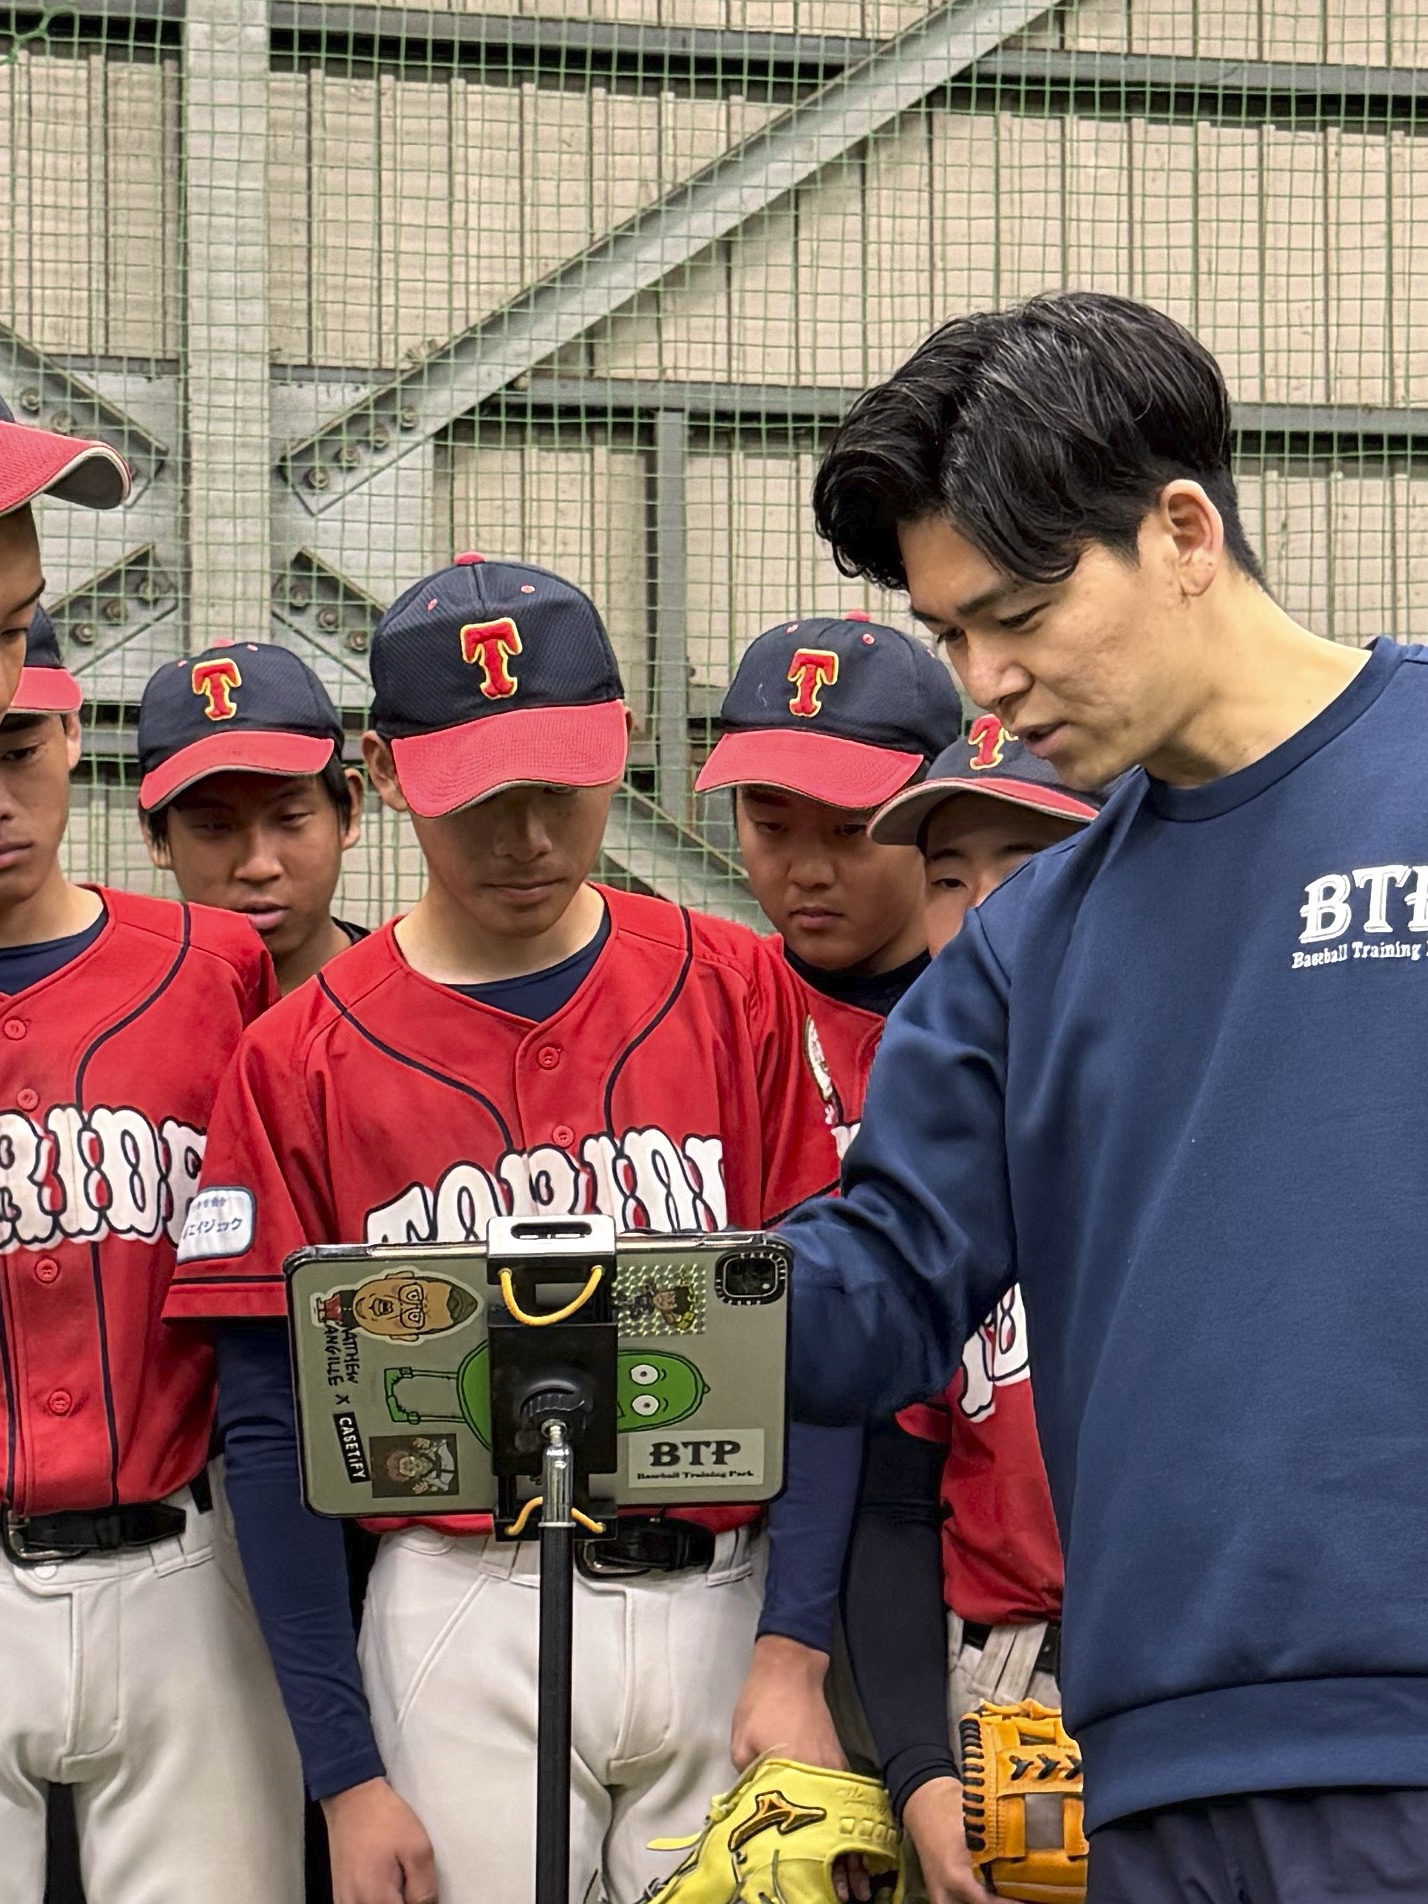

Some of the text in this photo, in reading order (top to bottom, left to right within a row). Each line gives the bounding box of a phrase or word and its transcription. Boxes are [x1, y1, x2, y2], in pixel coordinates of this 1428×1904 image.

[460, 617, 523, 700] T
[787, 648, 839, 718] T
[192, 658, 242, 721] T
[968, 713, 1019, 770] T
[1291, 943, 1348, 969] Baseball
[1352, 940, 1422, 961] Training
[324, 1325, 344, 1386] ANGILLE
[649, 1440, 741, 1467] BTP
